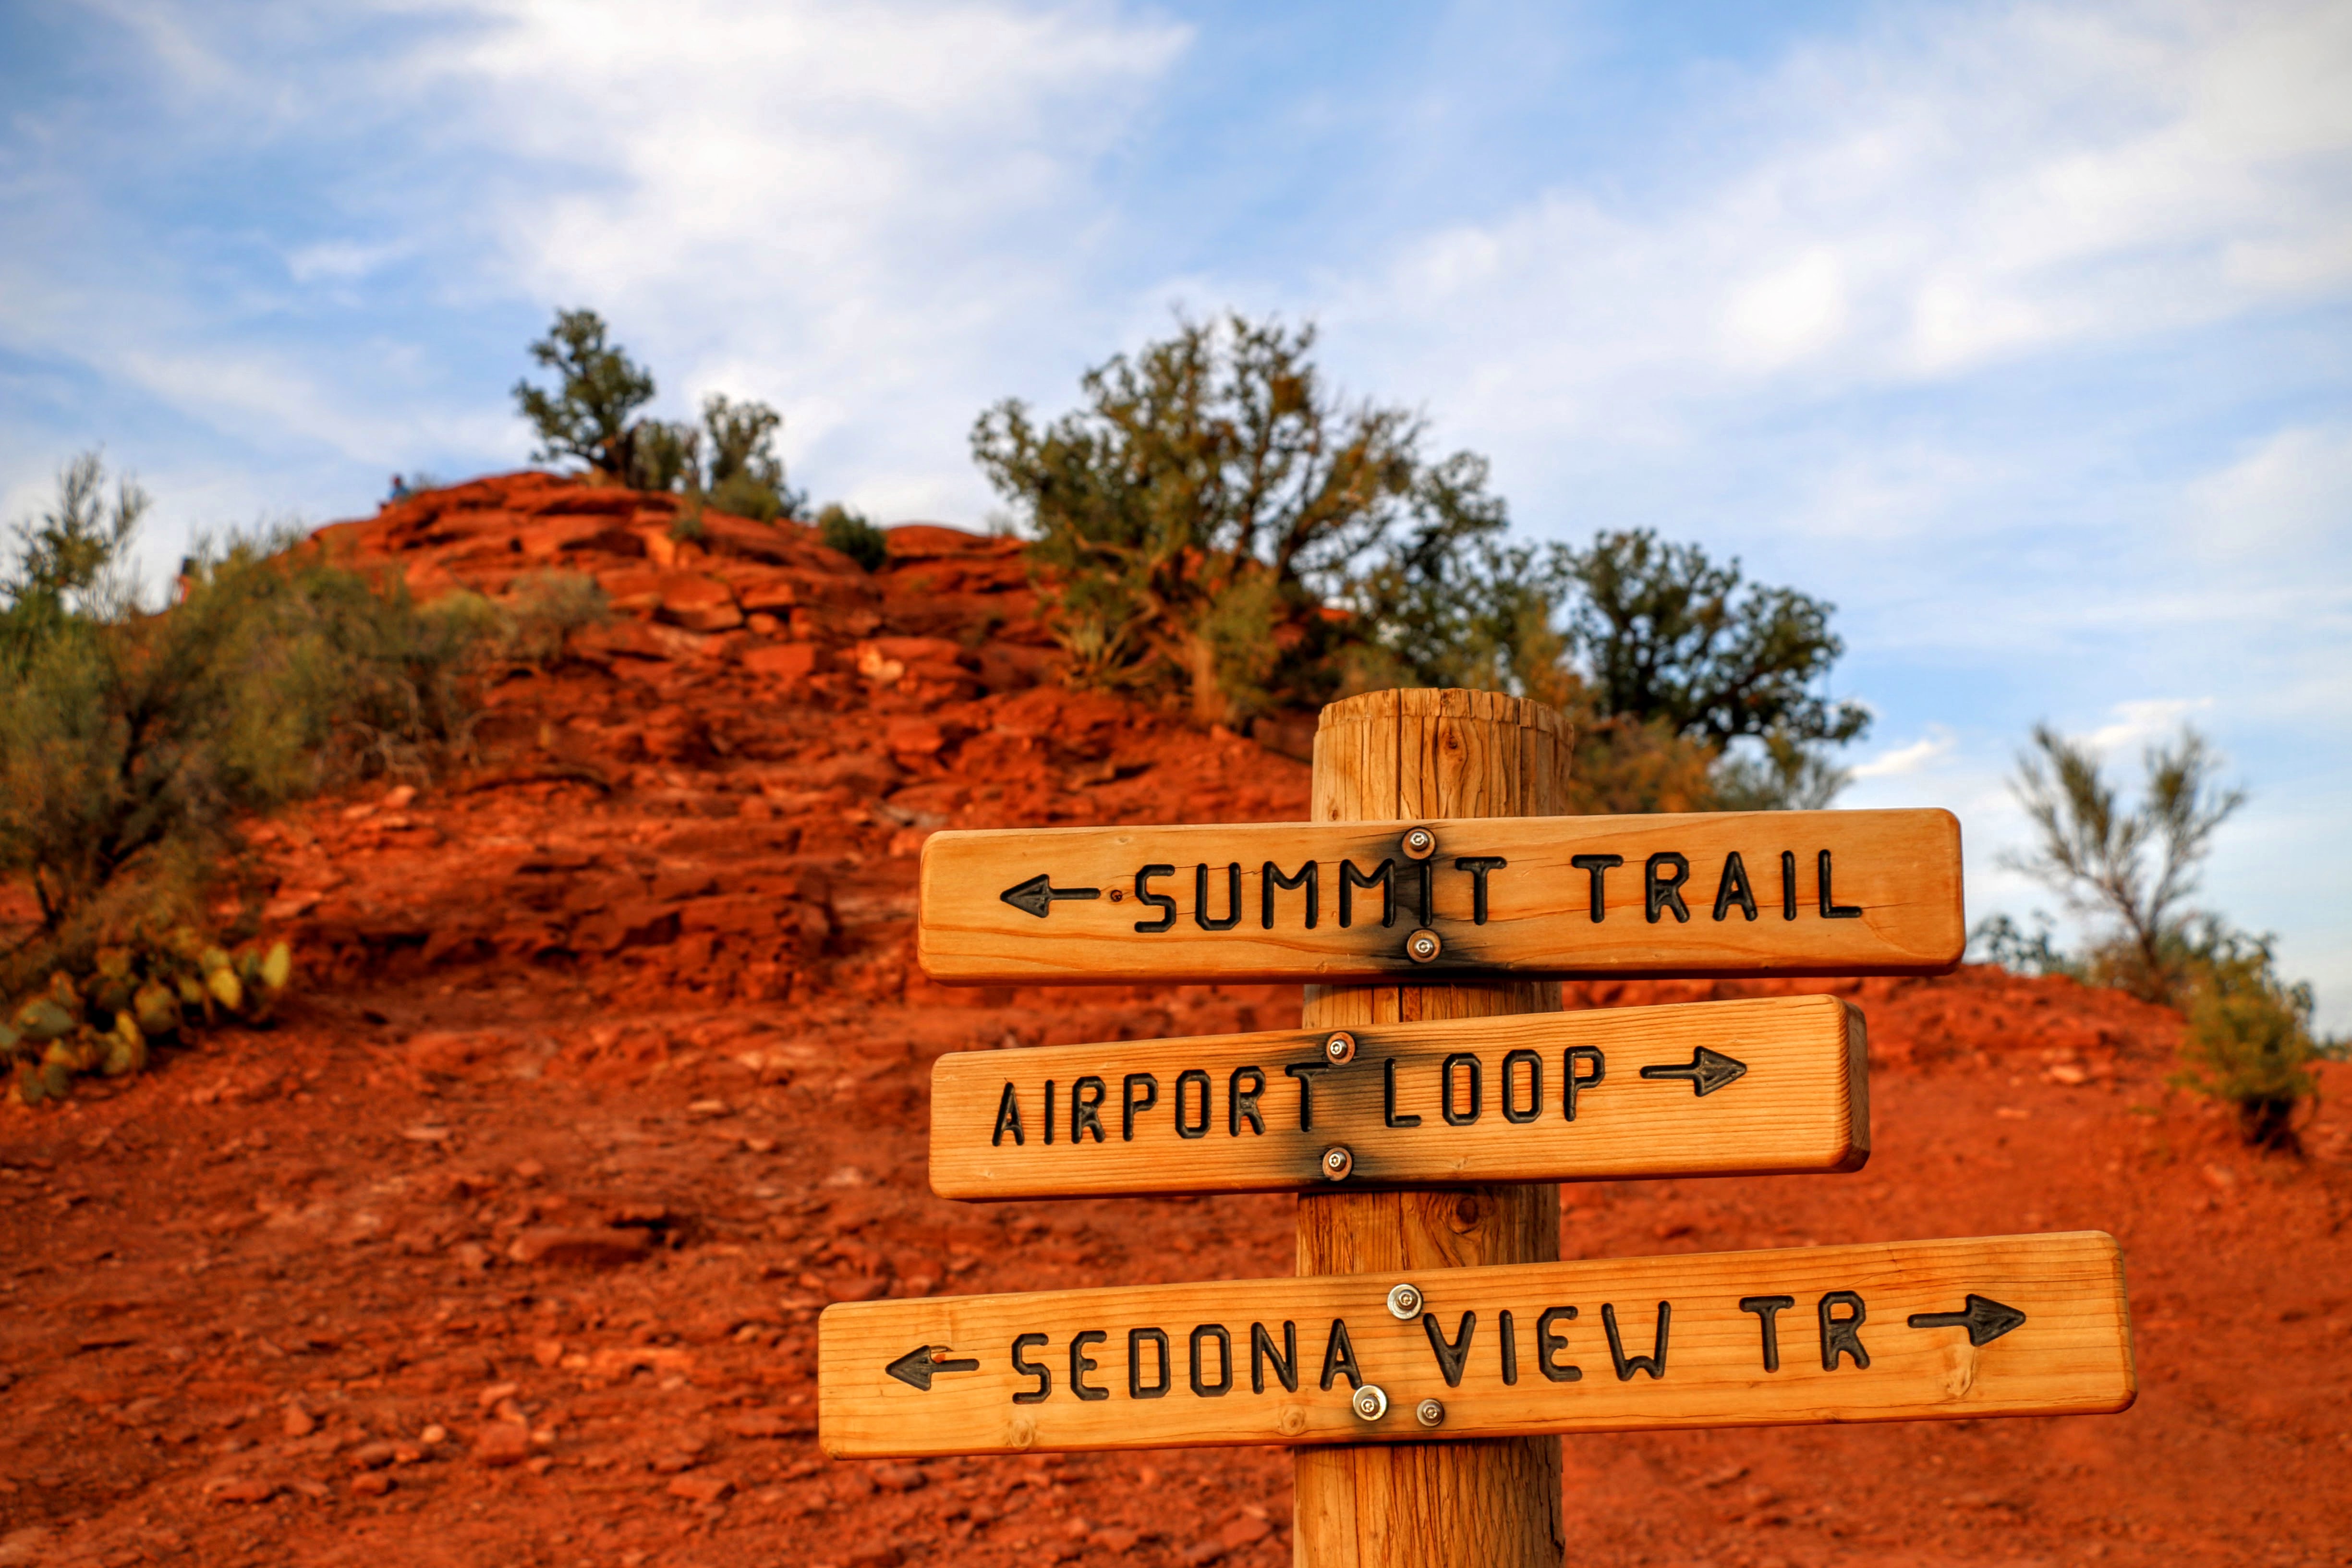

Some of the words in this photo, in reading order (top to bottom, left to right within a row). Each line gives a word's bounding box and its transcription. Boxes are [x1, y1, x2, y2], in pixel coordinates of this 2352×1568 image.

[1134, 856, 1507, 933] SUMMIT
[1571, 849, 1863, 924] TRAIL
[992, 1062, 1330, 1146] AIRPORT
[1384, 1045, 1605, 1127] LOOP
[1011, 1318, 1363, 1405] SEDONA
[1422, 1301, 1671, 1388] VIEW
[1739, 1290, 1871, 1374] TR
